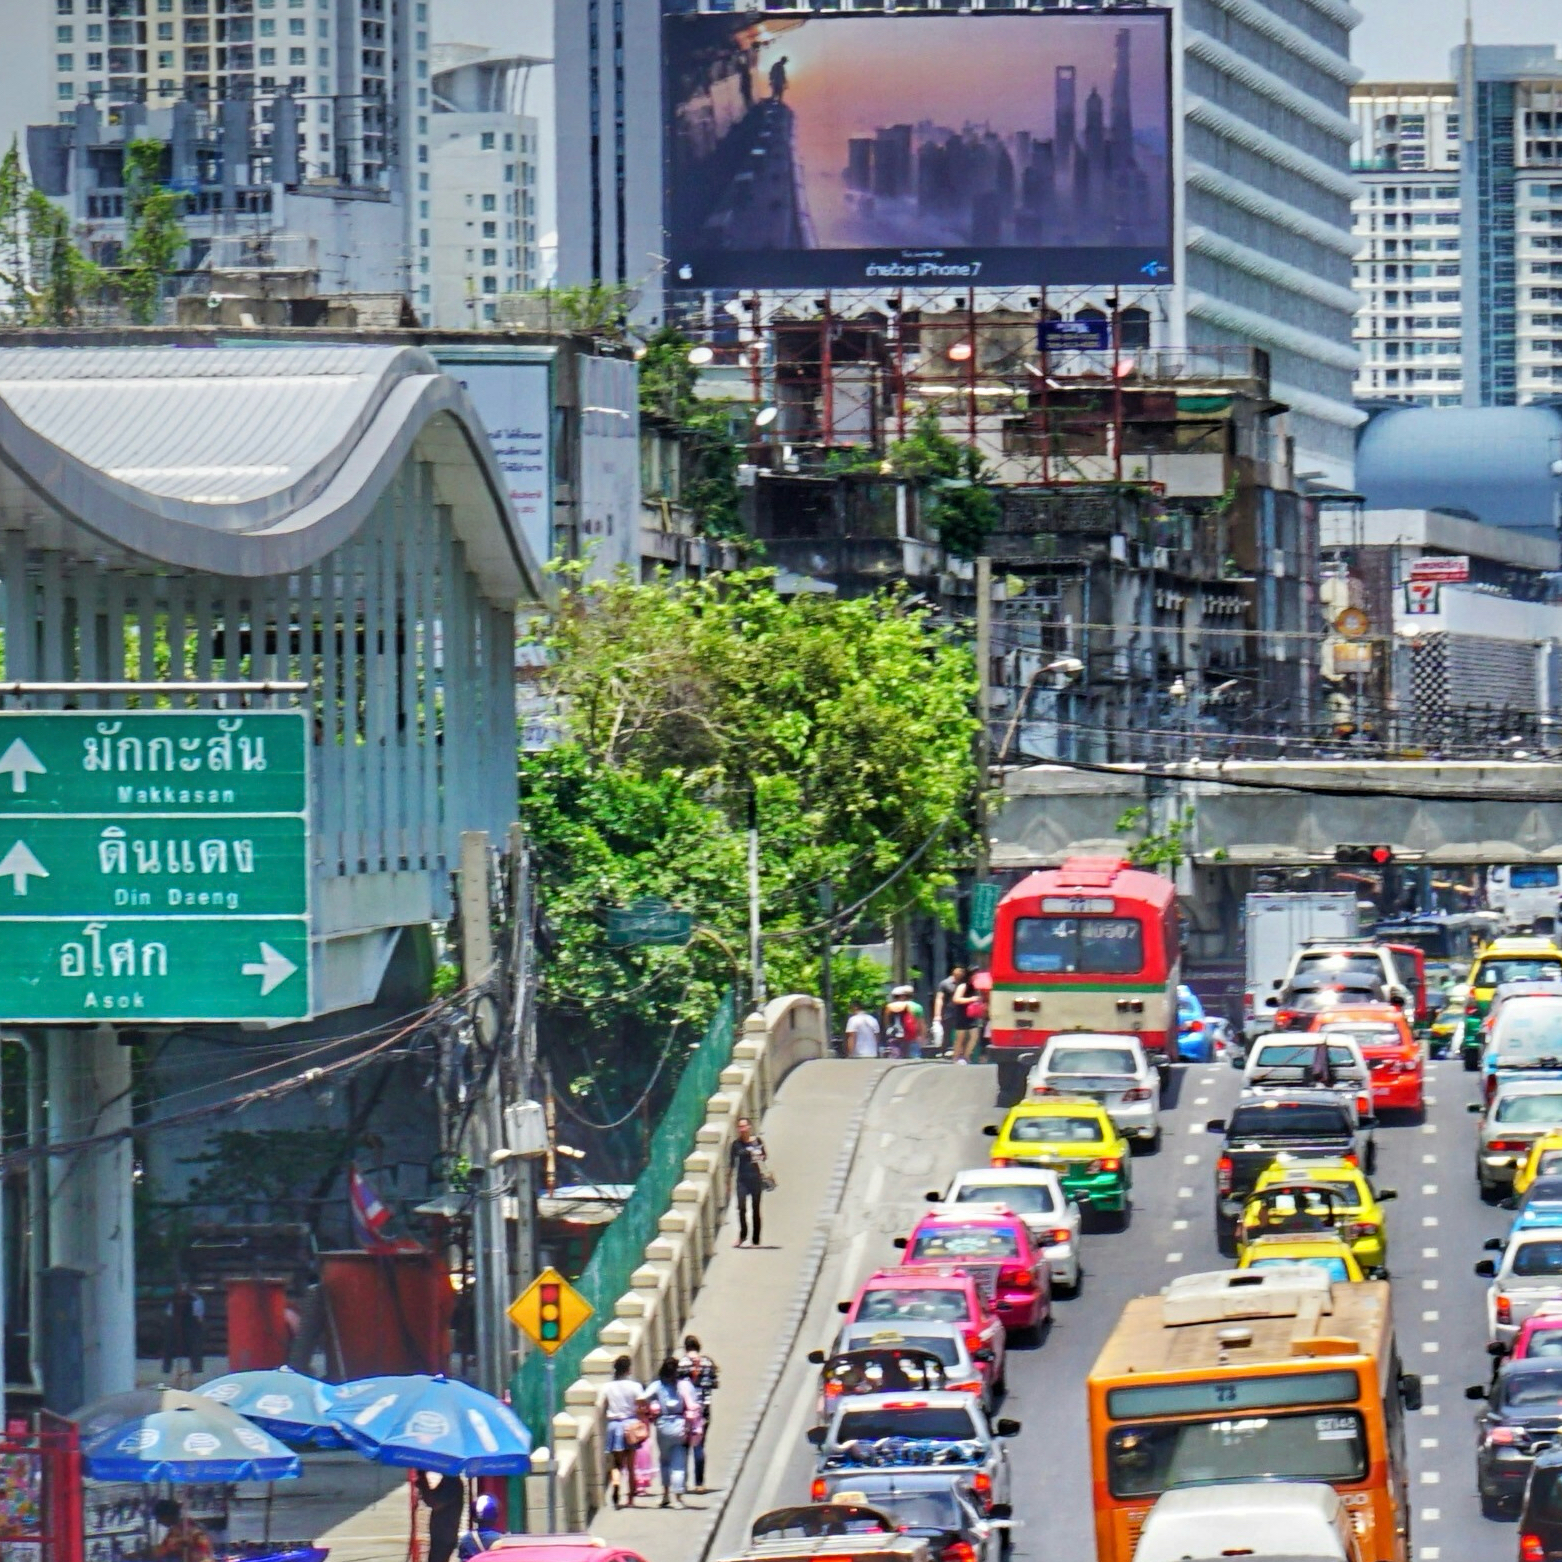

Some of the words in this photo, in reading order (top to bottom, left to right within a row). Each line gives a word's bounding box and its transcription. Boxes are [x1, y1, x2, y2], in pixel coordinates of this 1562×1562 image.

[917, 261, 969, 277] iPhone
[970, 261, 982, 276] 7
[83, 718, 267, 772] มักกะสัน
[118, 785, 235, 803] Makkasan
[99, 826, 254, 874] ดินแดง
[115, 889, 151, 906] Din
[168, 889, 239, 909] Daeng
[60, 923, 167, 977] อโศก
[84, 991, 144, 1009] Asok
